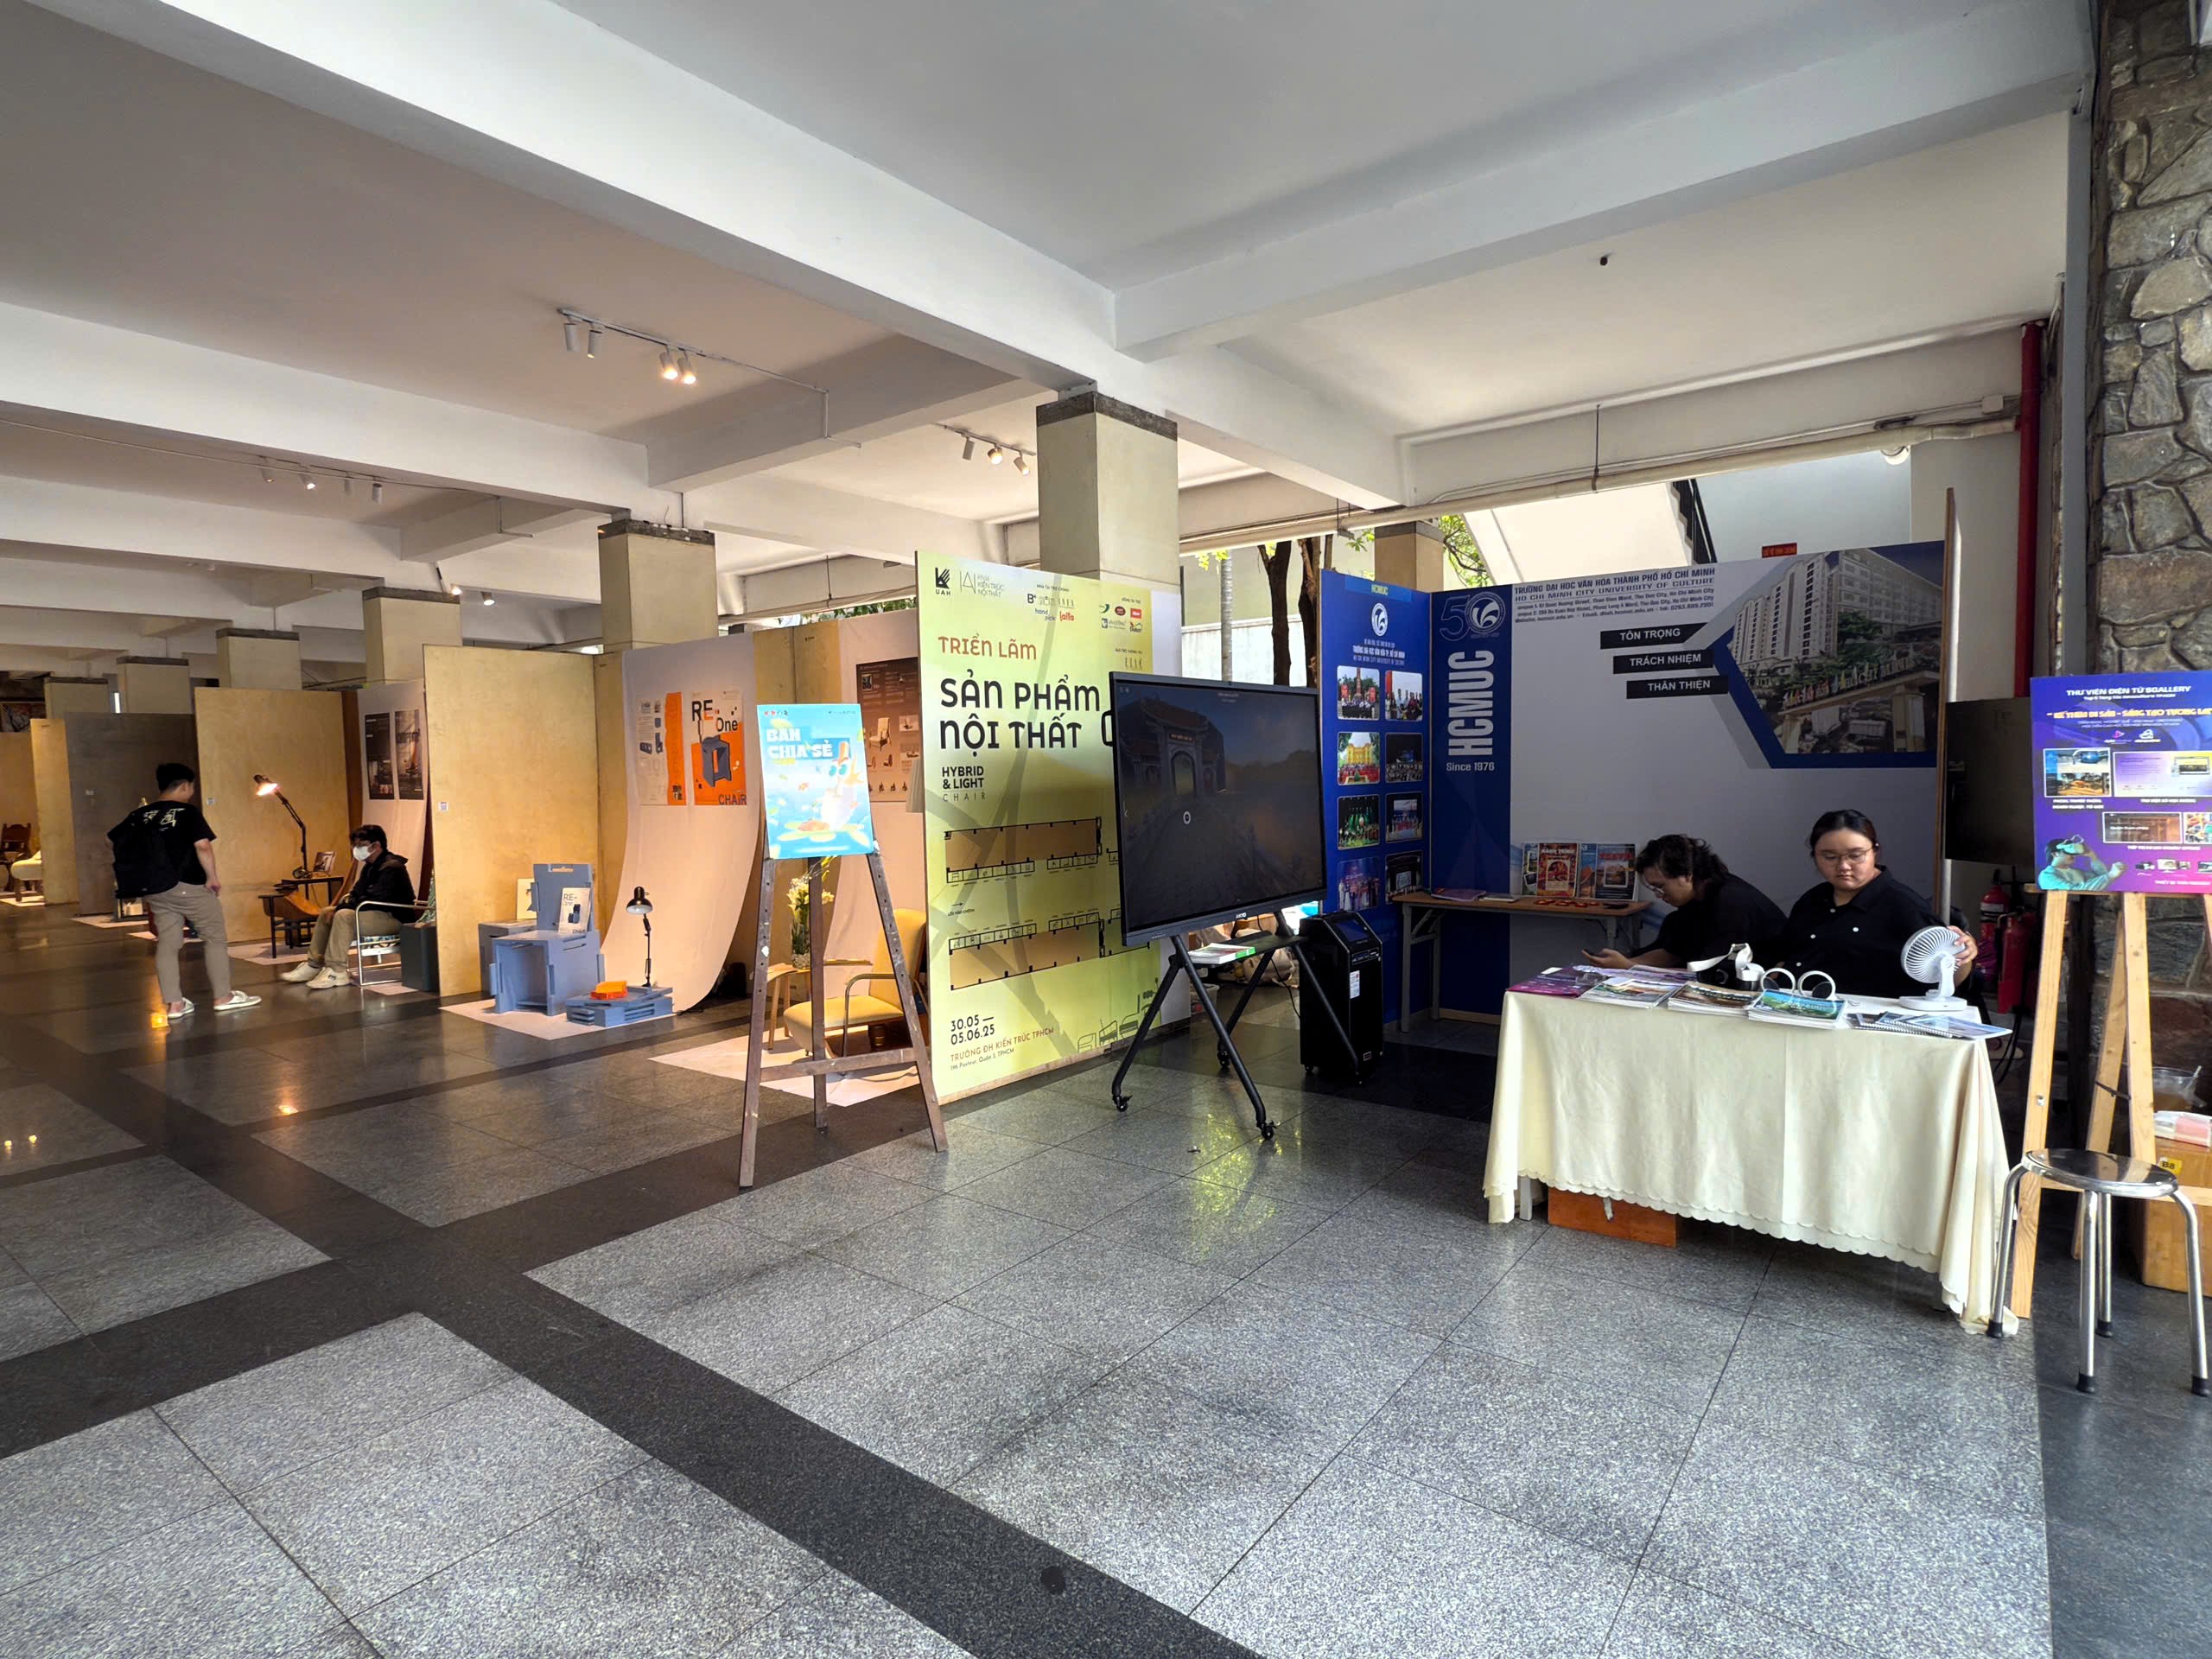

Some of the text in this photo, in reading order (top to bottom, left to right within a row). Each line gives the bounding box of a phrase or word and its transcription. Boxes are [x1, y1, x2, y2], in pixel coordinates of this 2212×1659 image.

[1692, 568, 1715, 577] MINH
[1599, 583, 1653, 594] UNIVERSITY
[1672, 578, 1715, 588] CULTURE
[1619, 628, 1681, 642] TÔN TRỌNG
[1630, 652, 1701, 666] TRÁCH NHIỆM
[1680, 679, 1711, 692] THIỆN
[1447, 650, 1496, 756] HCMUC
[716, 717, 738, 732] One
[1008, 712, 1083, 749] THẤT
[768, 744, 809, 759] CHIA
[942, 766, 984, 777] HYBRID
[1446, 761, 1495, 772] Since 1976
[943, 778, 984, 789] & LIGHT
[719, 794, 747, 805] CHAIR
[943, 792, 985, 802] CHAIR
[950, 1014, 980, 1032] 30.05
[950, 1024, 995, 1046] 05.06.25
[1033, 1027, 1054, 1039] TPHCM
